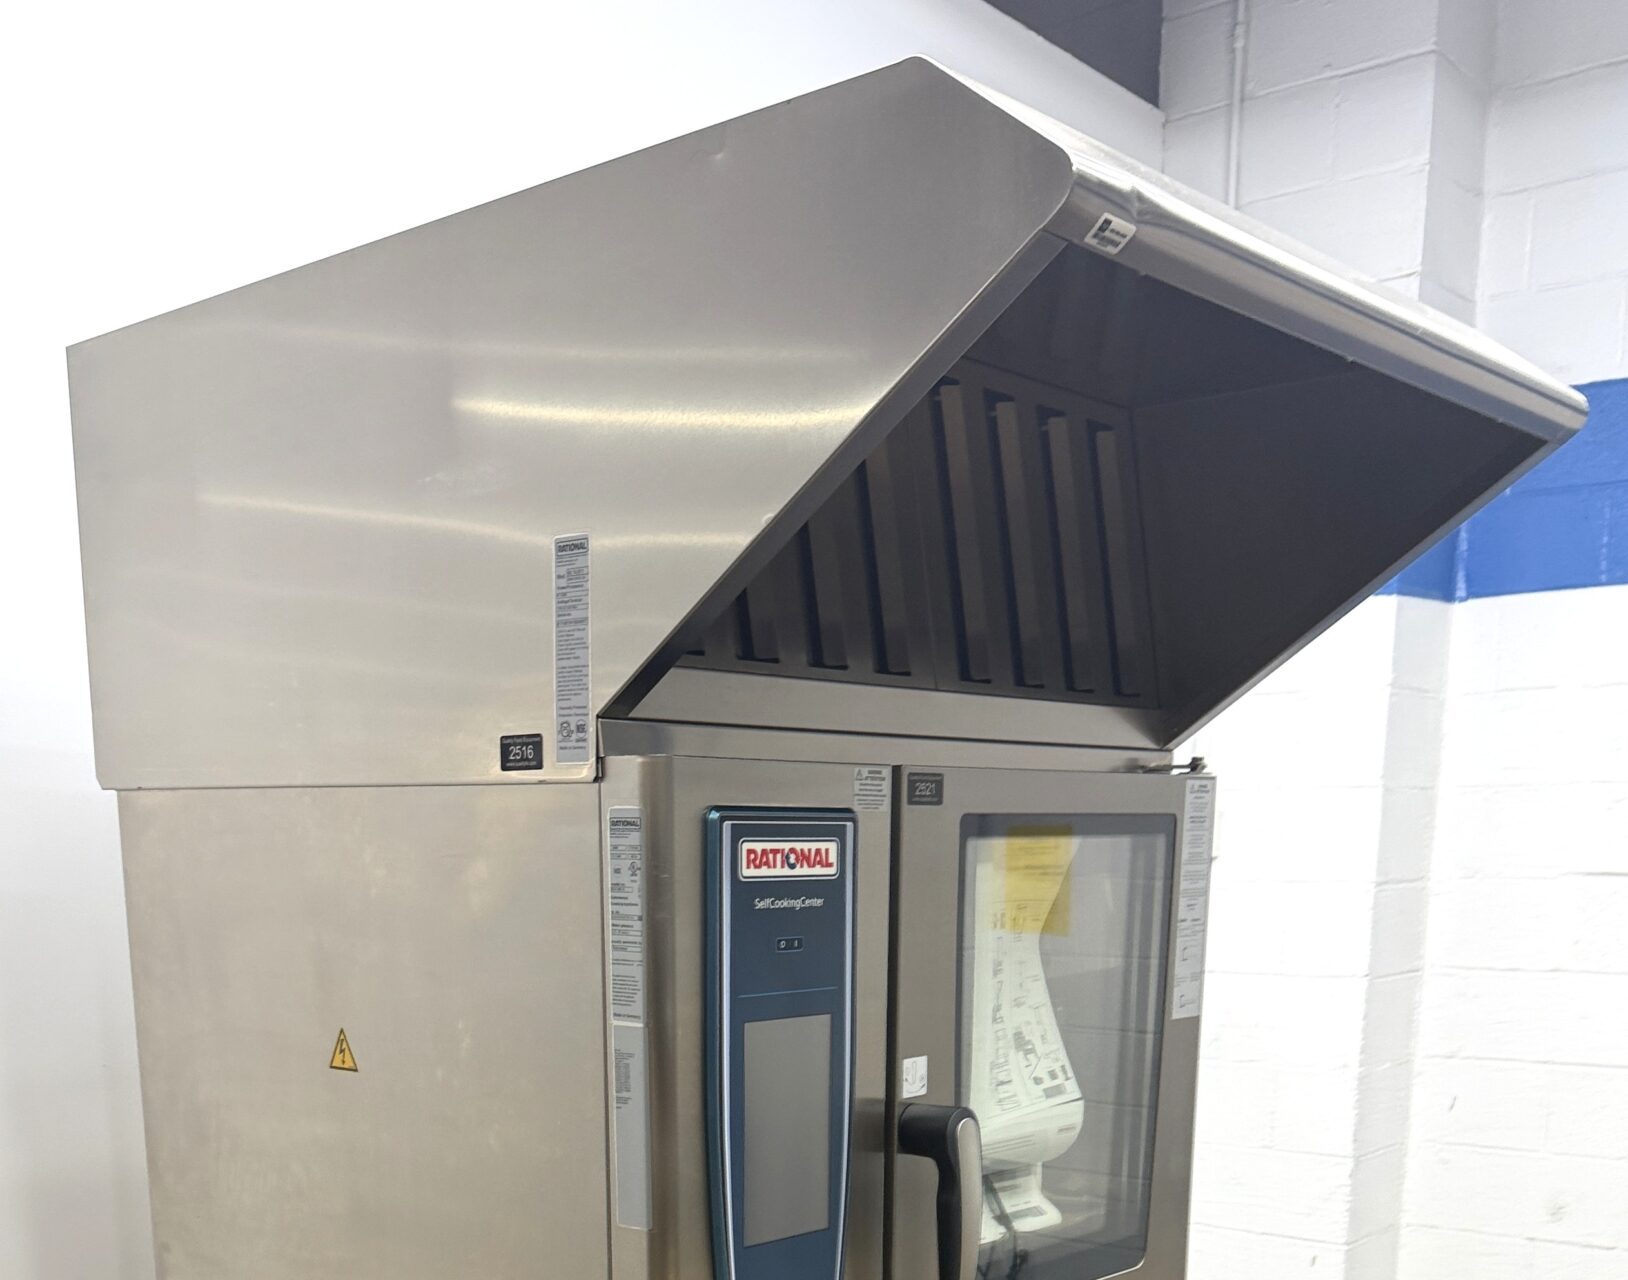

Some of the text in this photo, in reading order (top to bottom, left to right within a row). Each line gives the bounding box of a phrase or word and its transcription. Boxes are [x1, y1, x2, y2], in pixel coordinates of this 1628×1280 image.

[508, 744, 534, 760] 2516
[914, 782, 936, 796] 2521
[745, 847, 835, 870] RATIONAL
[754, 896, 825, 911] SelfCookingCenter
